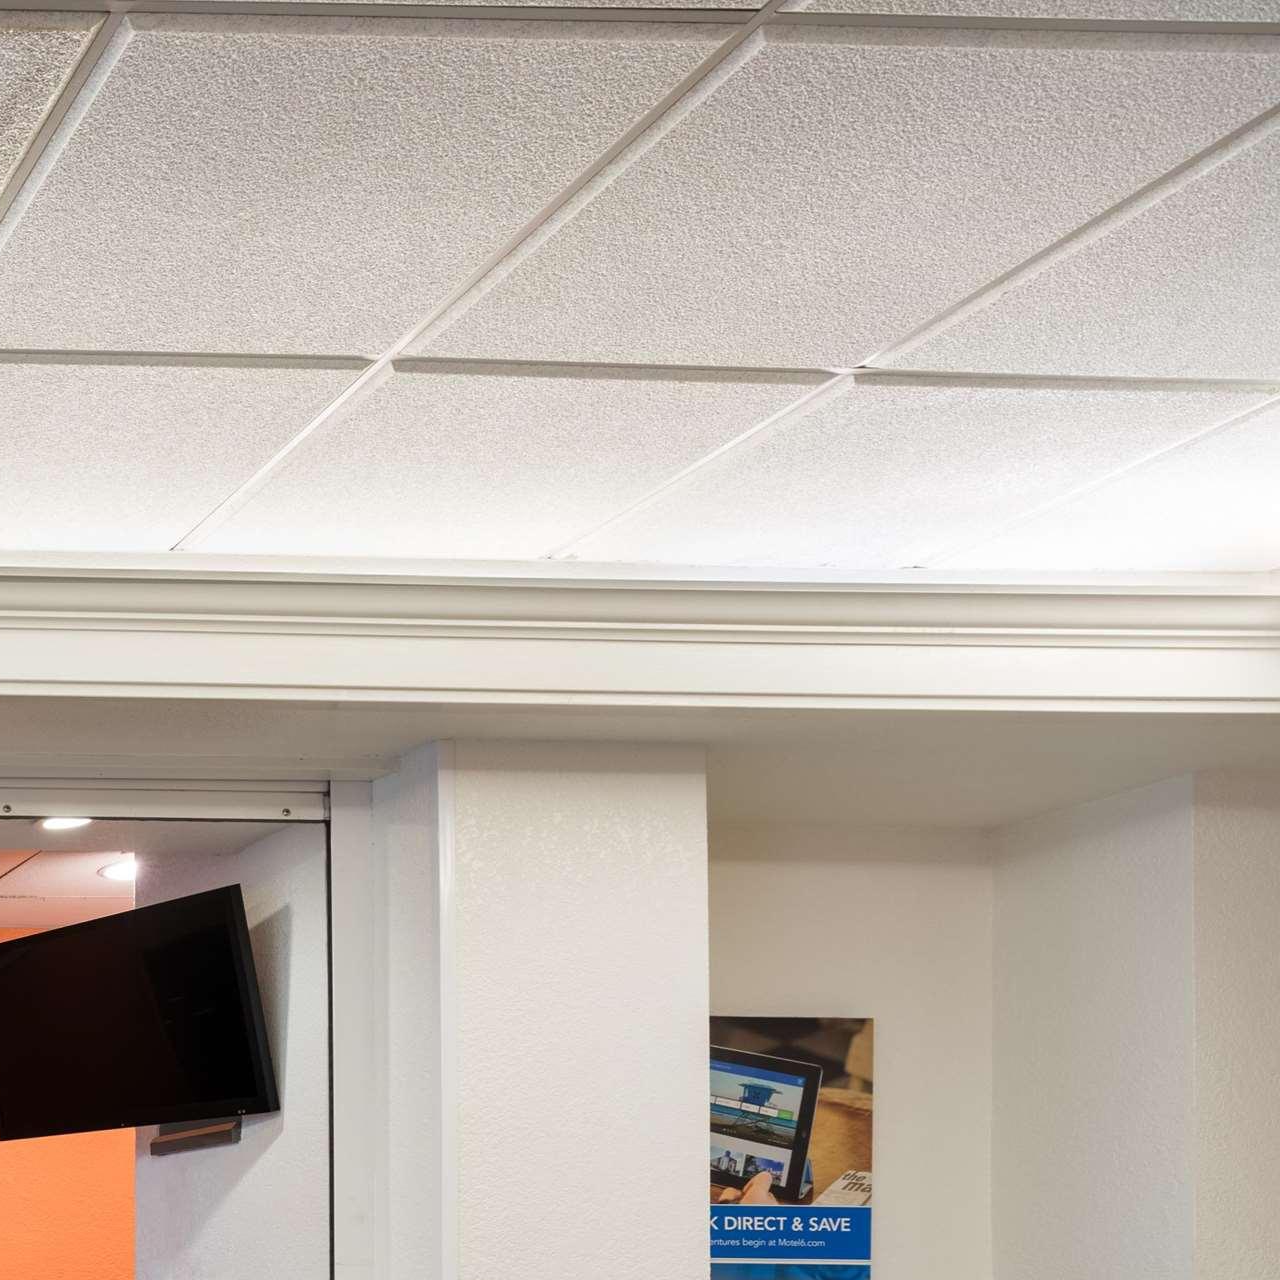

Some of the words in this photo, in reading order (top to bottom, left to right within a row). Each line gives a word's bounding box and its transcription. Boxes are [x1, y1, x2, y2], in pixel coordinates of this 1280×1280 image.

[842, 1171, 867, 1182] the
[724, 1217, 787, 1231] DIRECT
[792, 1217, 804, 1231] &
[809, 1217, 852, 1232] SAVE
[742, 1238, 766, 1249] begin
[768, 1239, 776, 1247] at
[778, 1238, 825, 1247] Motel6.com
